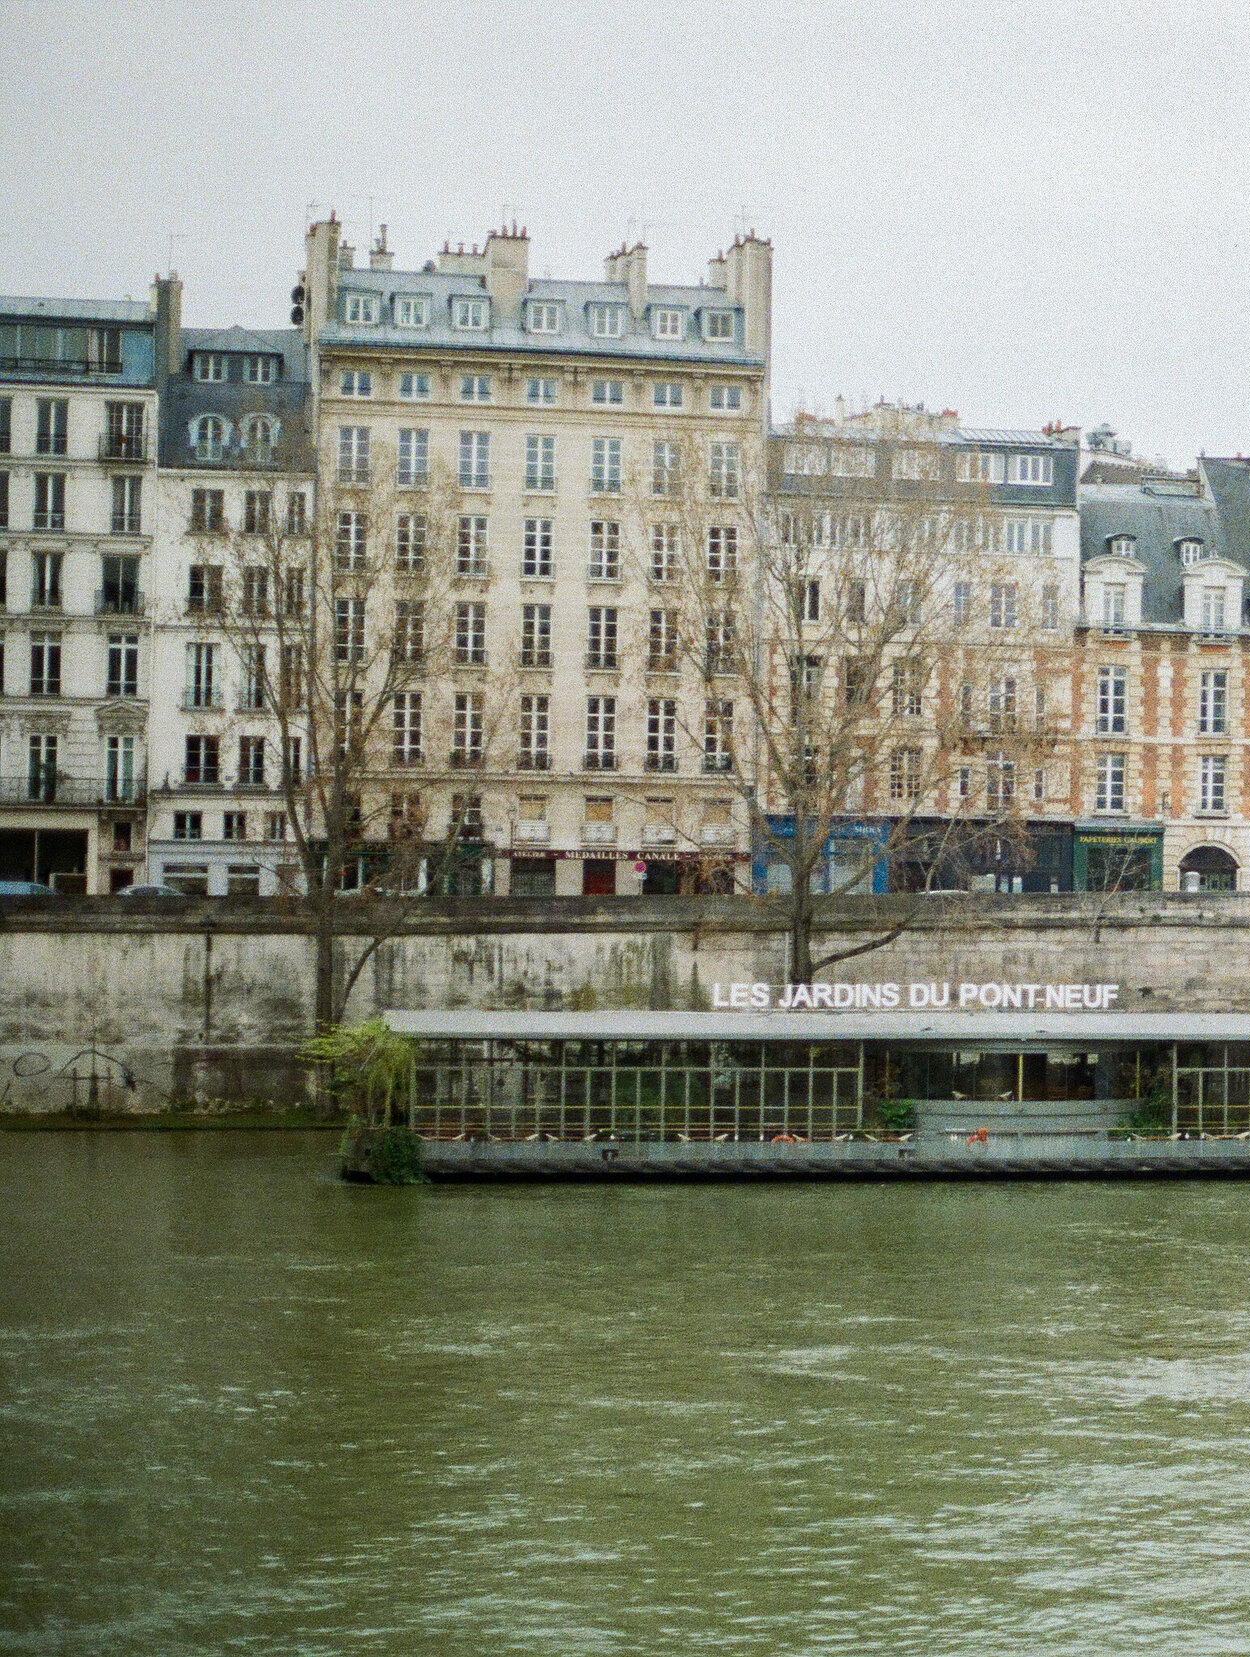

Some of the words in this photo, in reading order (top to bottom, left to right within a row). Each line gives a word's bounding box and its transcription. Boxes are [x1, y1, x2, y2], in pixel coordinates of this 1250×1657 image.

[712, 982, 770, 1007] LES
[779, 982, 900, 1007] JARDINS
[908, 982, 950, 1007] DU
[958, 982, 1120, 1008] PONT-NEUF
